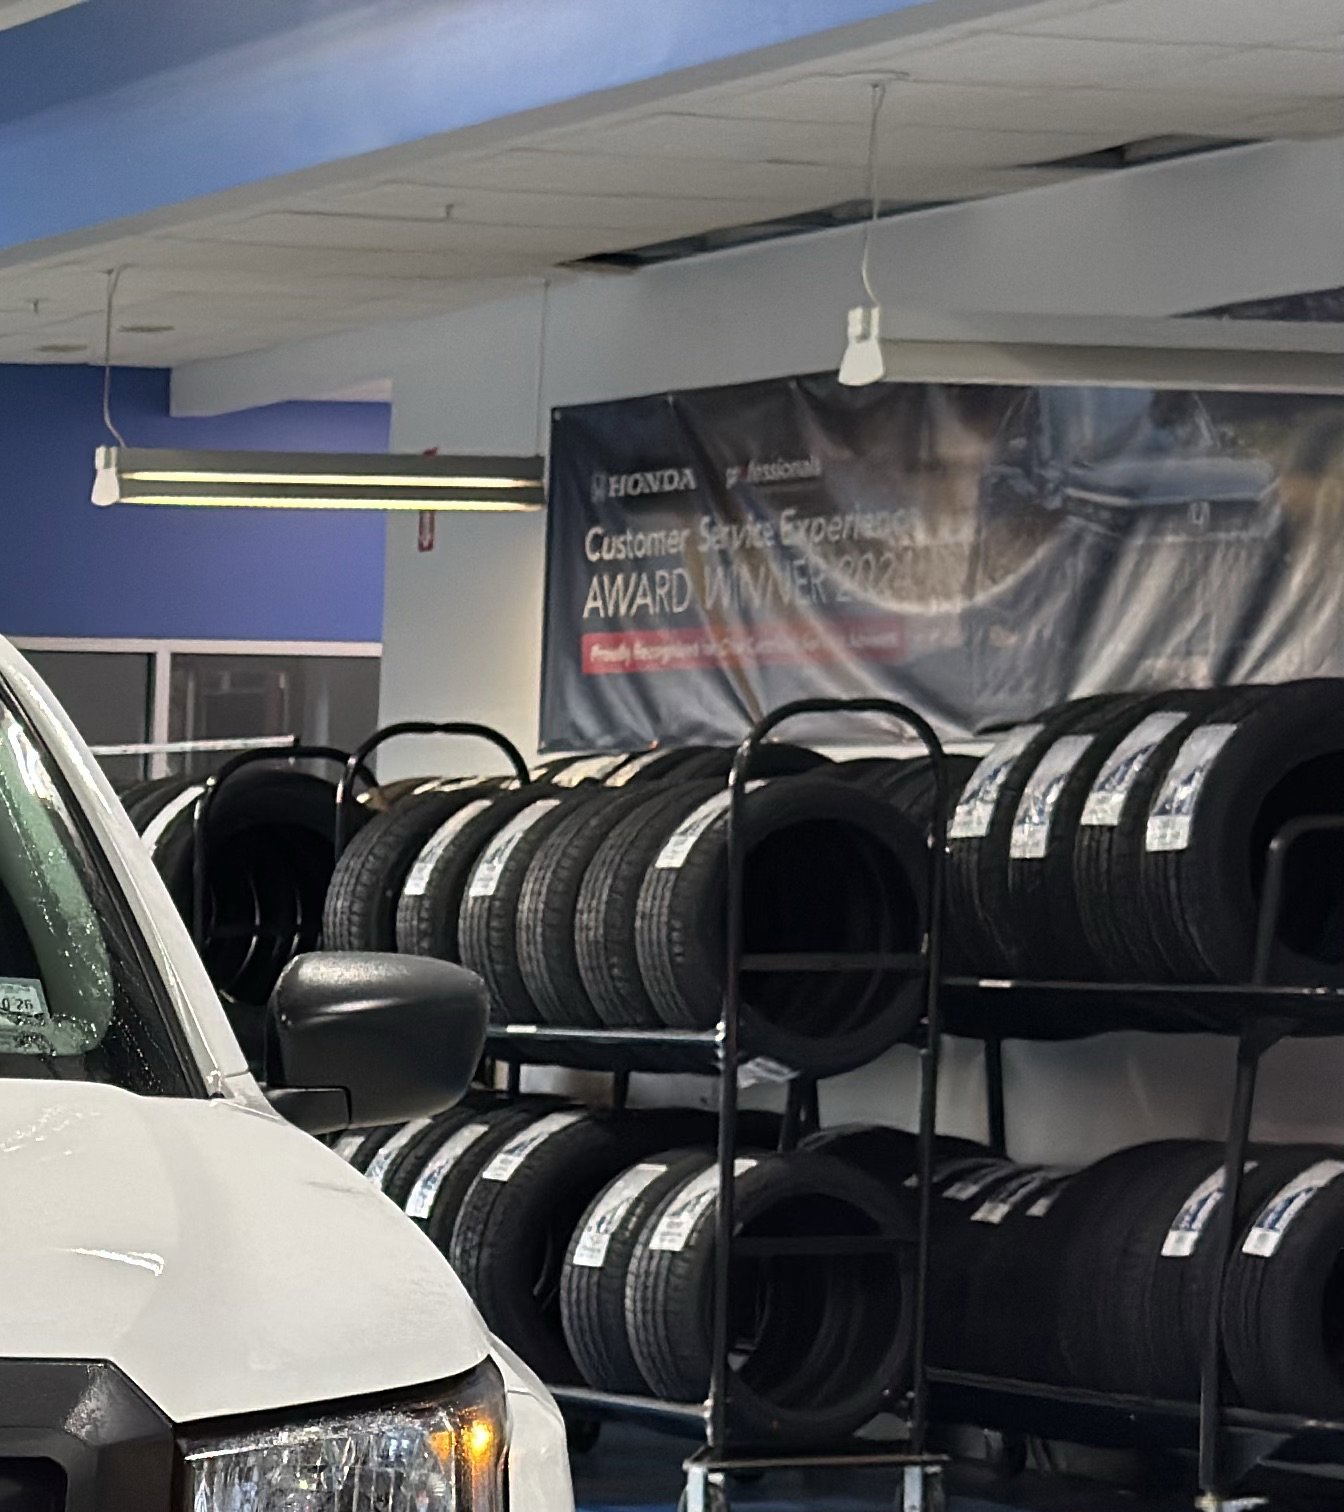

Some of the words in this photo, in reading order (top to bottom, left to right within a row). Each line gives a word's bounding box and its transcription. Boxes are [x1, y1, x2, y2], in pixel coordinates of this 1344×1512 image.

[608, 467, 696, 498] HONDA
[584, 526, 691, 562] Customer
[582, 568, 691, 618] AWARD
